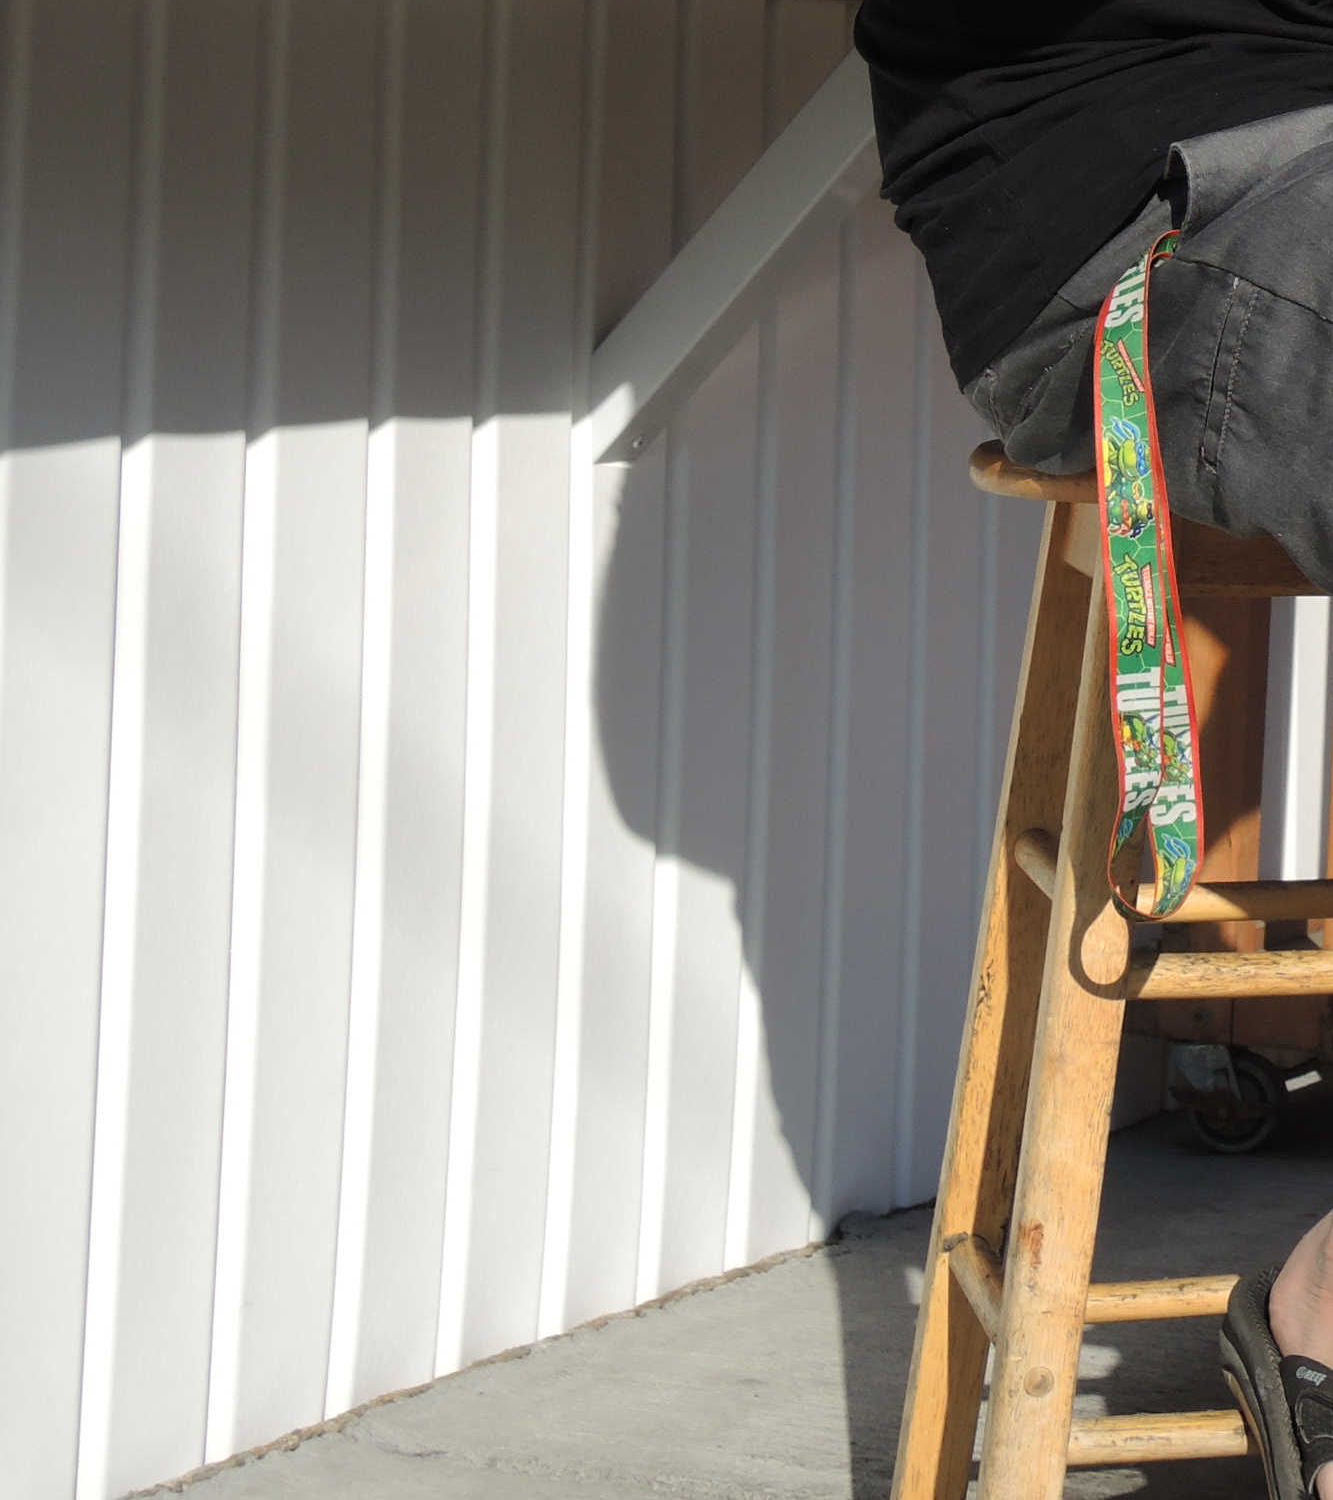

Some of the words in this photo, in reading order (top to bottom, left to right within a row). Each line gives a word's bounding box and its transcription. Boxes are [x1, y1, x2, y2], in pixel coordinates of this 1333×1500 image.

[1101, 339, 1138, 407] TURTLES
[1112, 553, 1147, 657] TURTLES
[1303, 1369, 1328, 1387] REEF
